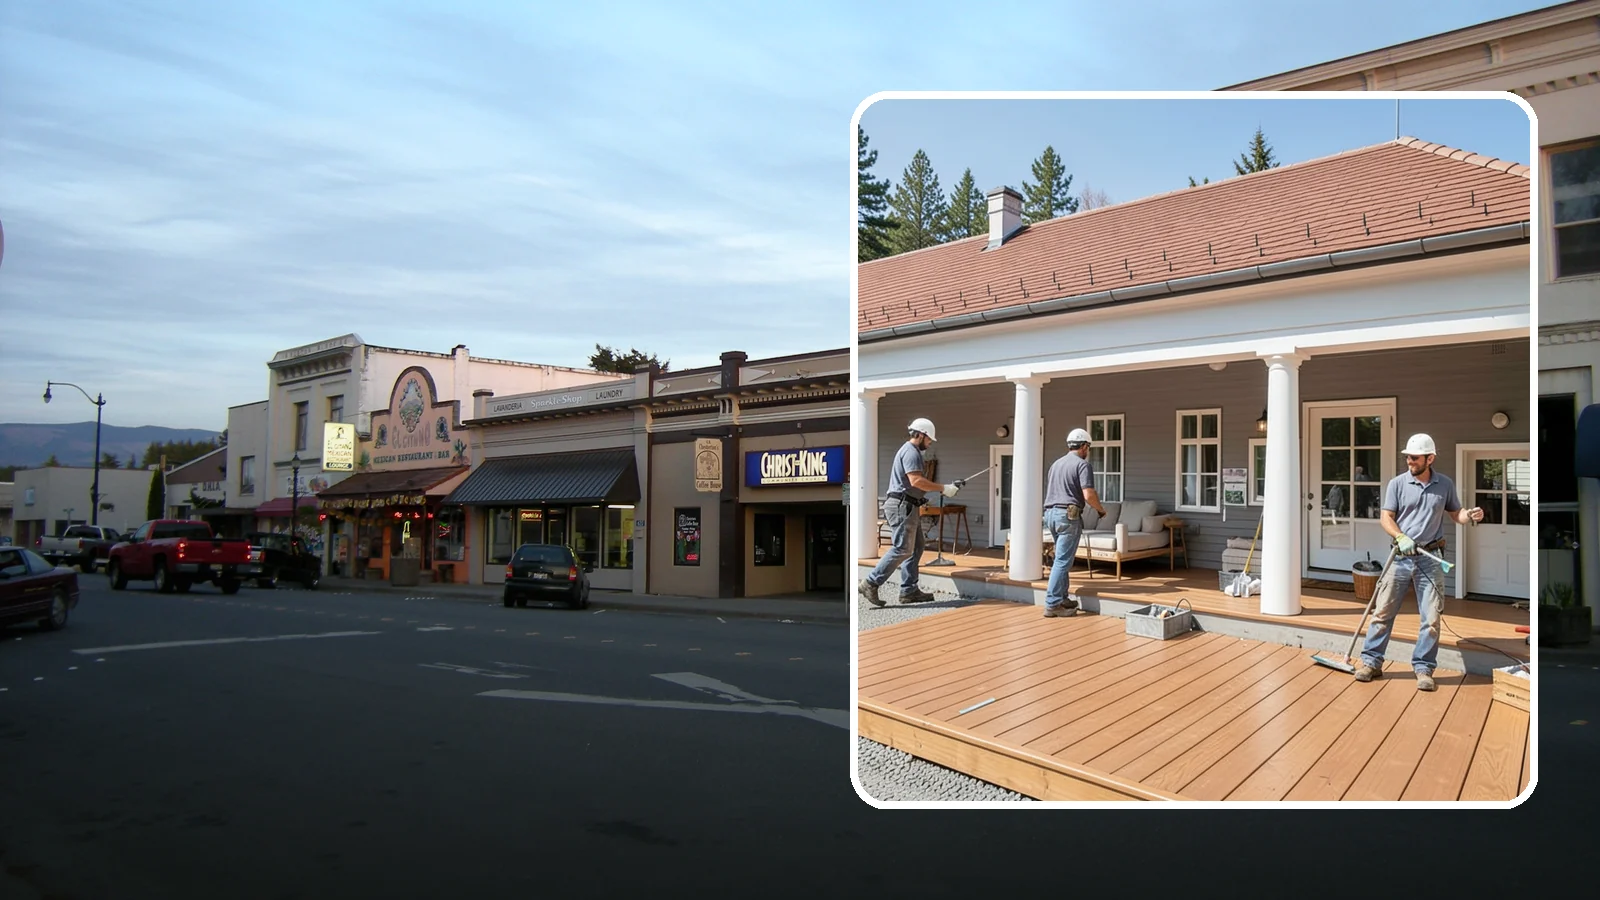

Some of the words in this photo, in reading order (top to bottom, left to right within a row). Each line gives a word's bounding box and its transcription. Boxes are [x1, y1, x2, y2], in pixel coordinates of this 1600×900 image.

[494, 402, 522, 412] LAVANDERIA
[530, 396, 560, 409] Sparkle
[562, 394, 583, 406] Shop
[595, 389, 624, 400] LAUNDRY
[373, 454, 396, 464] MEXICAN
[397, 451, 433, 462] RESTAURANT
[438, 450, 450, 459] BAR
[696, 481, 710, 489] Coffee
